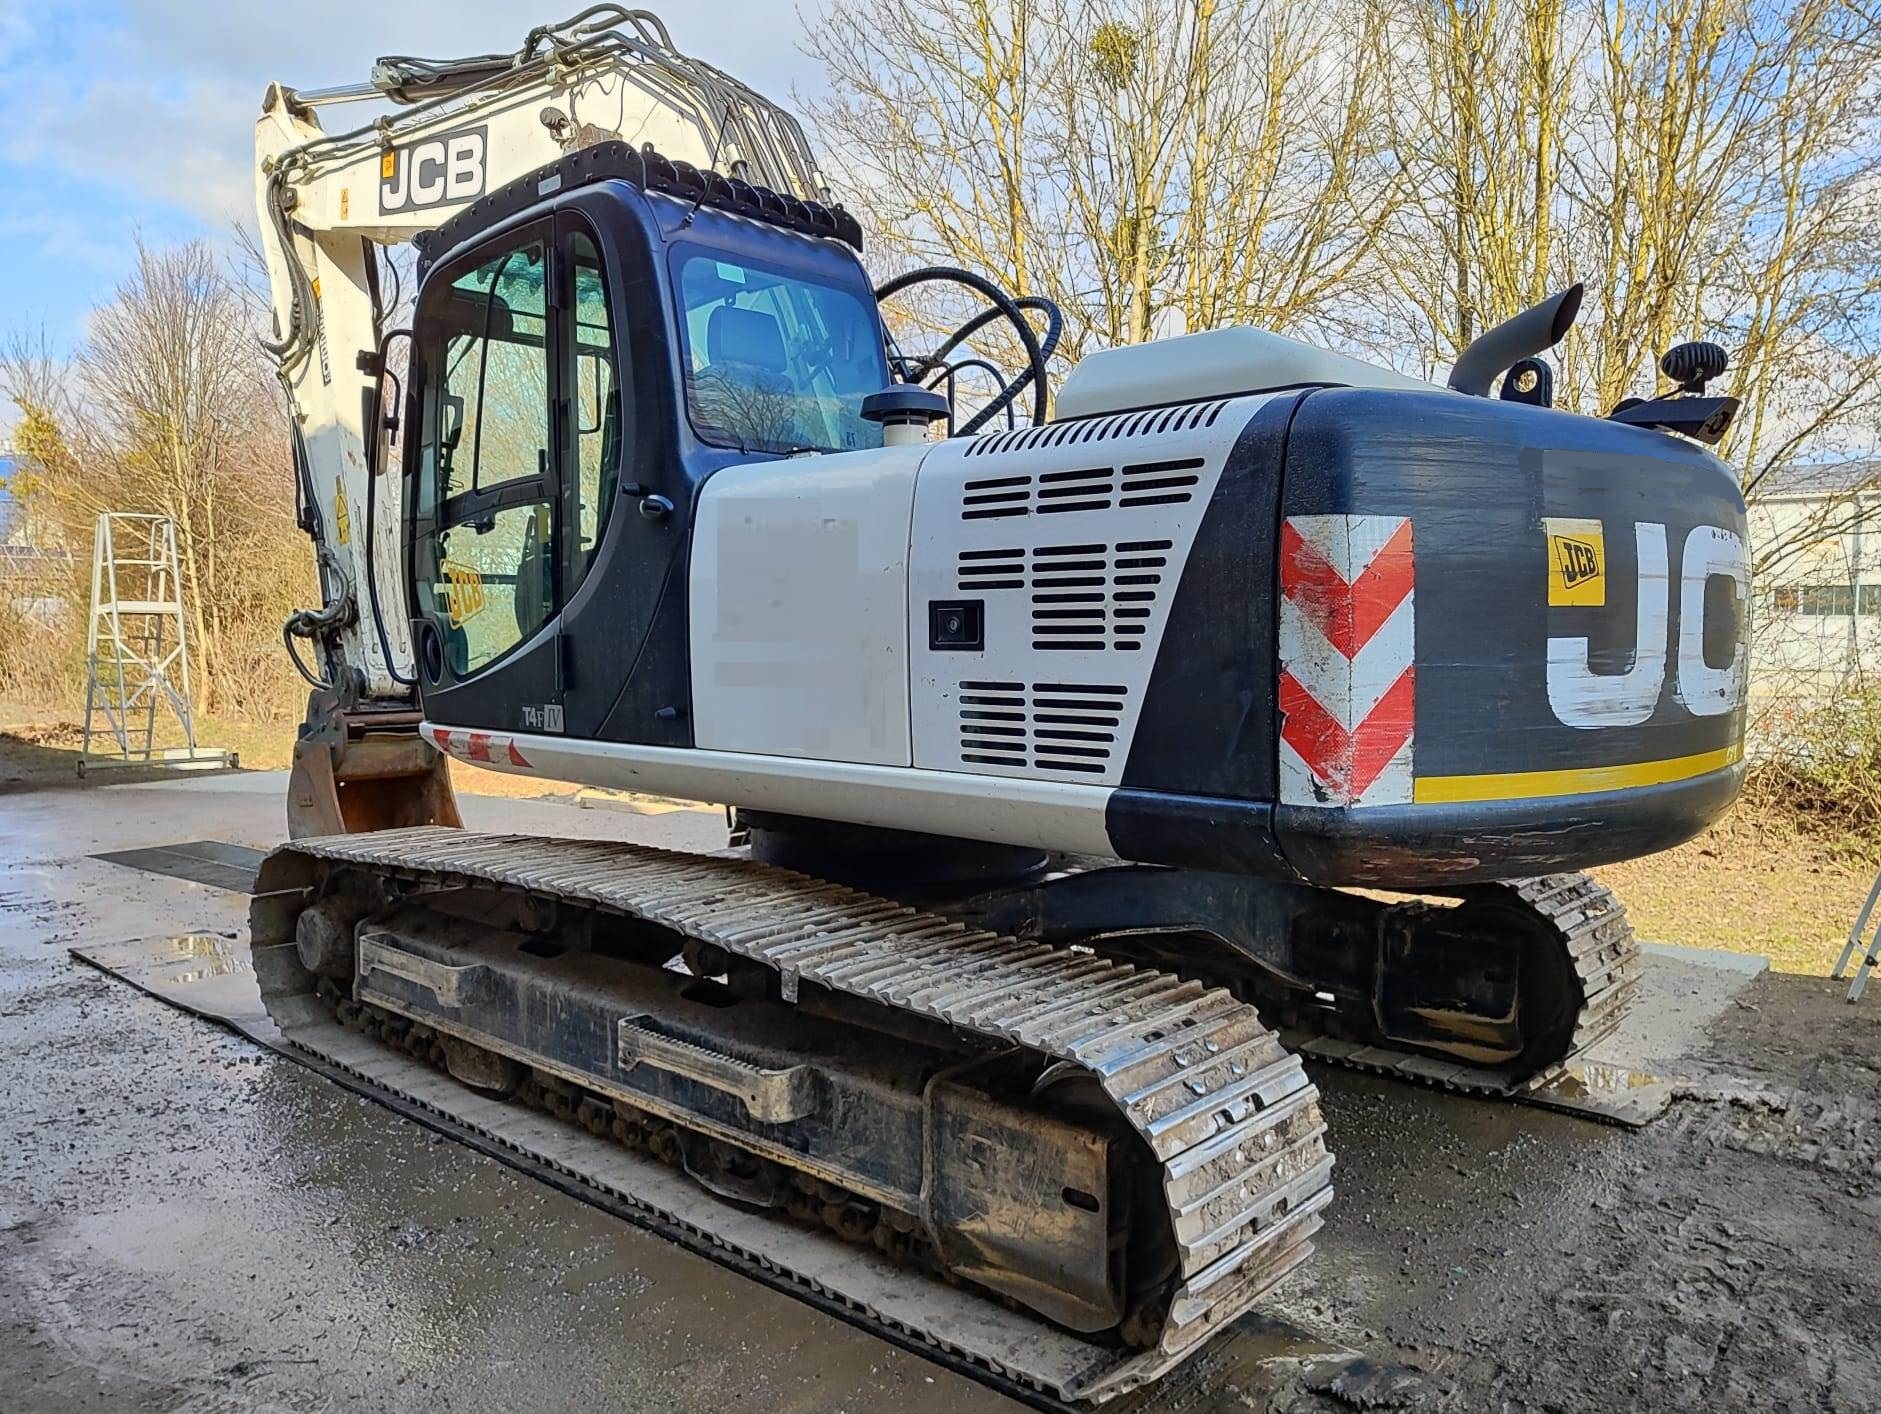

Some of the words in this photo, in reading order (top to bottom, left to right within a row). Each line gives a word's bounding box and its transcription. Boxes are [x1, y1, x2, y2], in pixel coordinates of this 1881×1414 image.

[382, 134, 483, 210] JCB
[448, 567, 482, 618] JCB
[1563, 542, 1596, 582] JCB
[1547, 521, 1748, 729] JC
